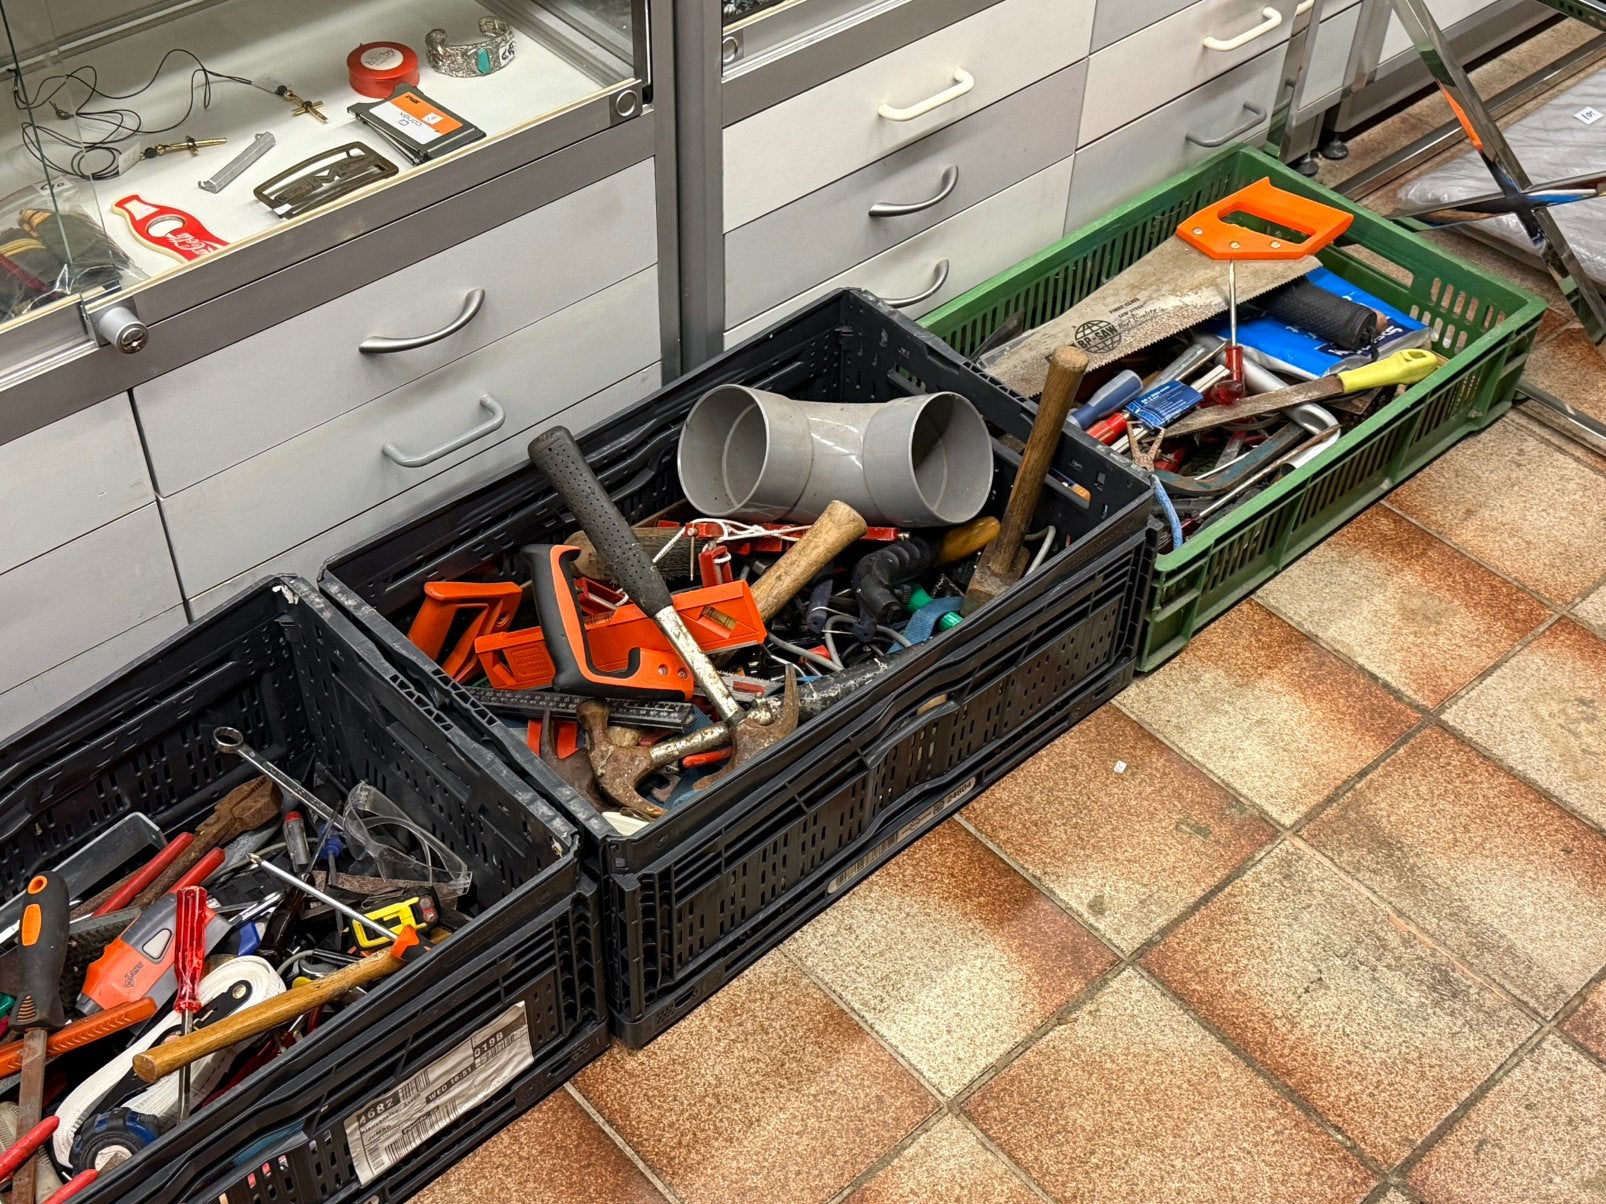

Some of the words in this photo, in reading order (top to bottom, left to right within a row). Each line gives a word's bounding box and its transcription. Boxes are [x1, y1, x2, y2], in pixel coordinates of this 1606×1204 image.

[1077, 324, 1119, 348] BP-SAW
[428, 1085, 448, 1101] WED
[360, 1098, 394, 1125] 4682
